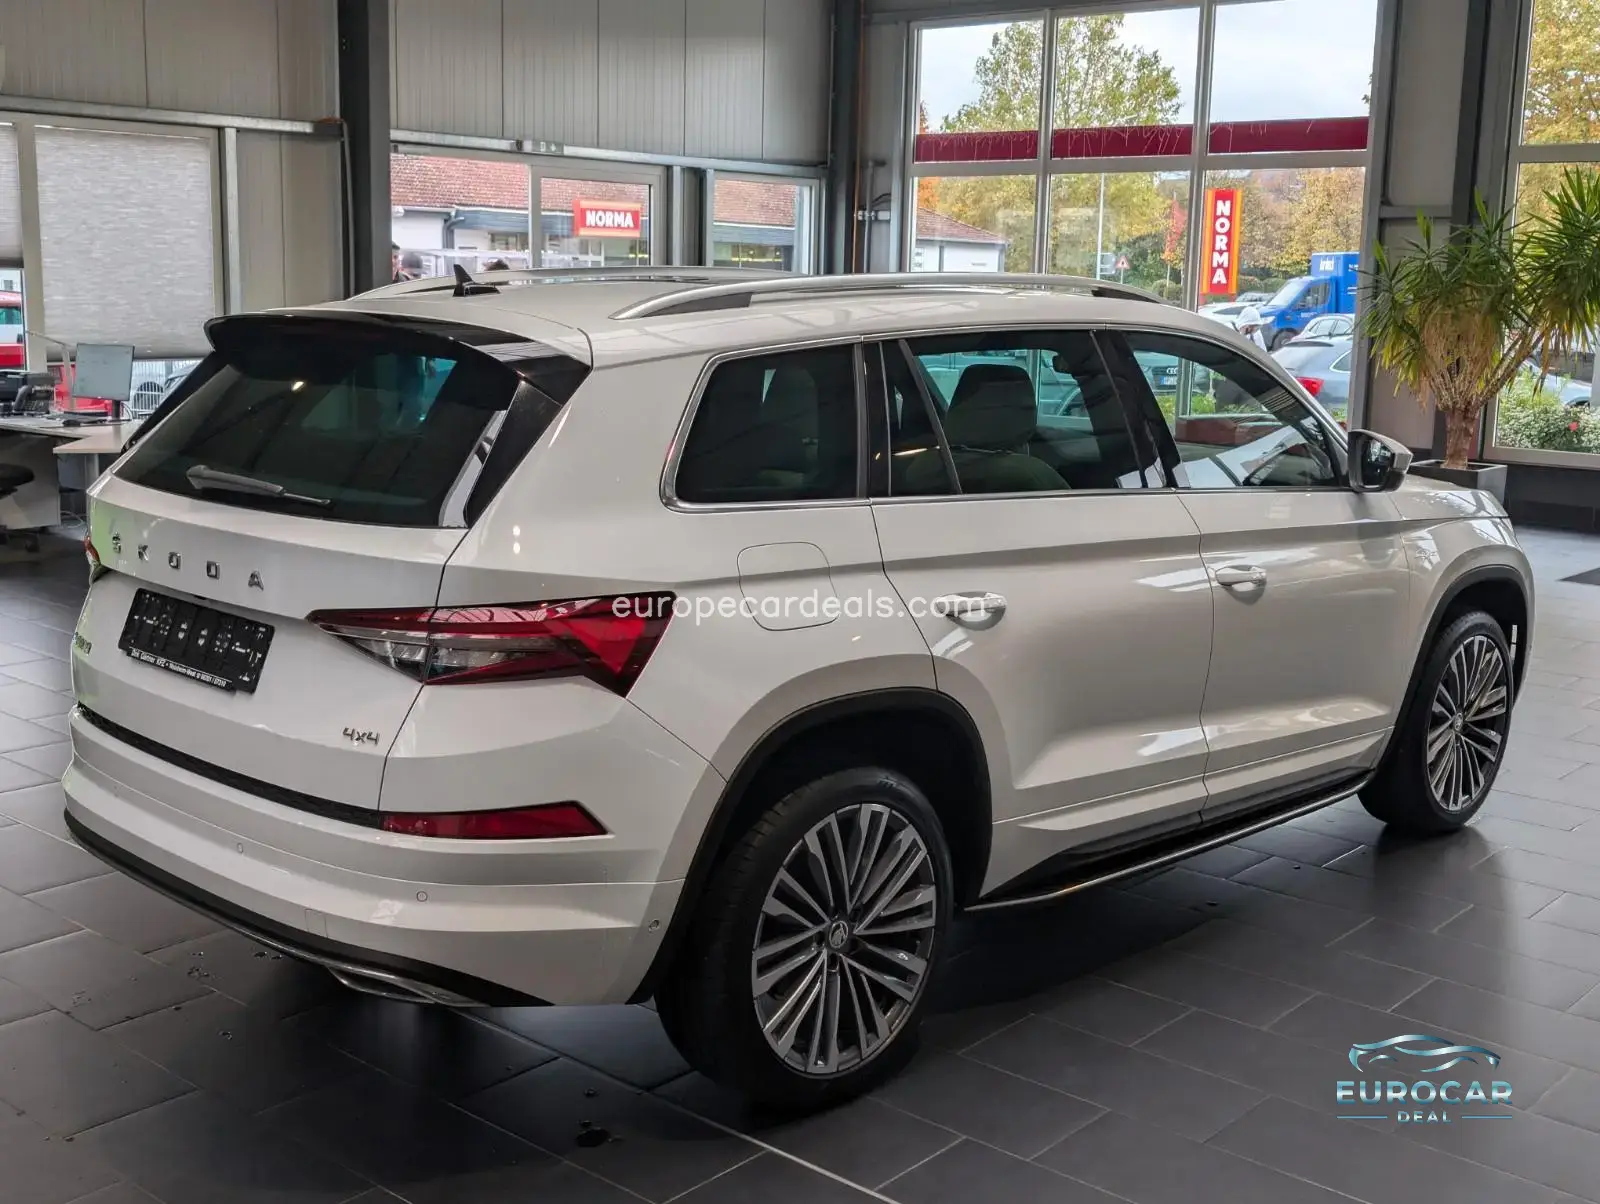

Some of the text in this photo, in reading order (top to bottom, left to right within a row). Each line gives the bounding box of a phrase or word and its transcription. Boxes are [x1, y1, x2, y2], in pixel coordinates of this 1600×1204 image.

[585, 209, 635, 229] NORMA
[1211, 200, 1231, 285] NORMA
[342, 727, 380, 746] 4x4
